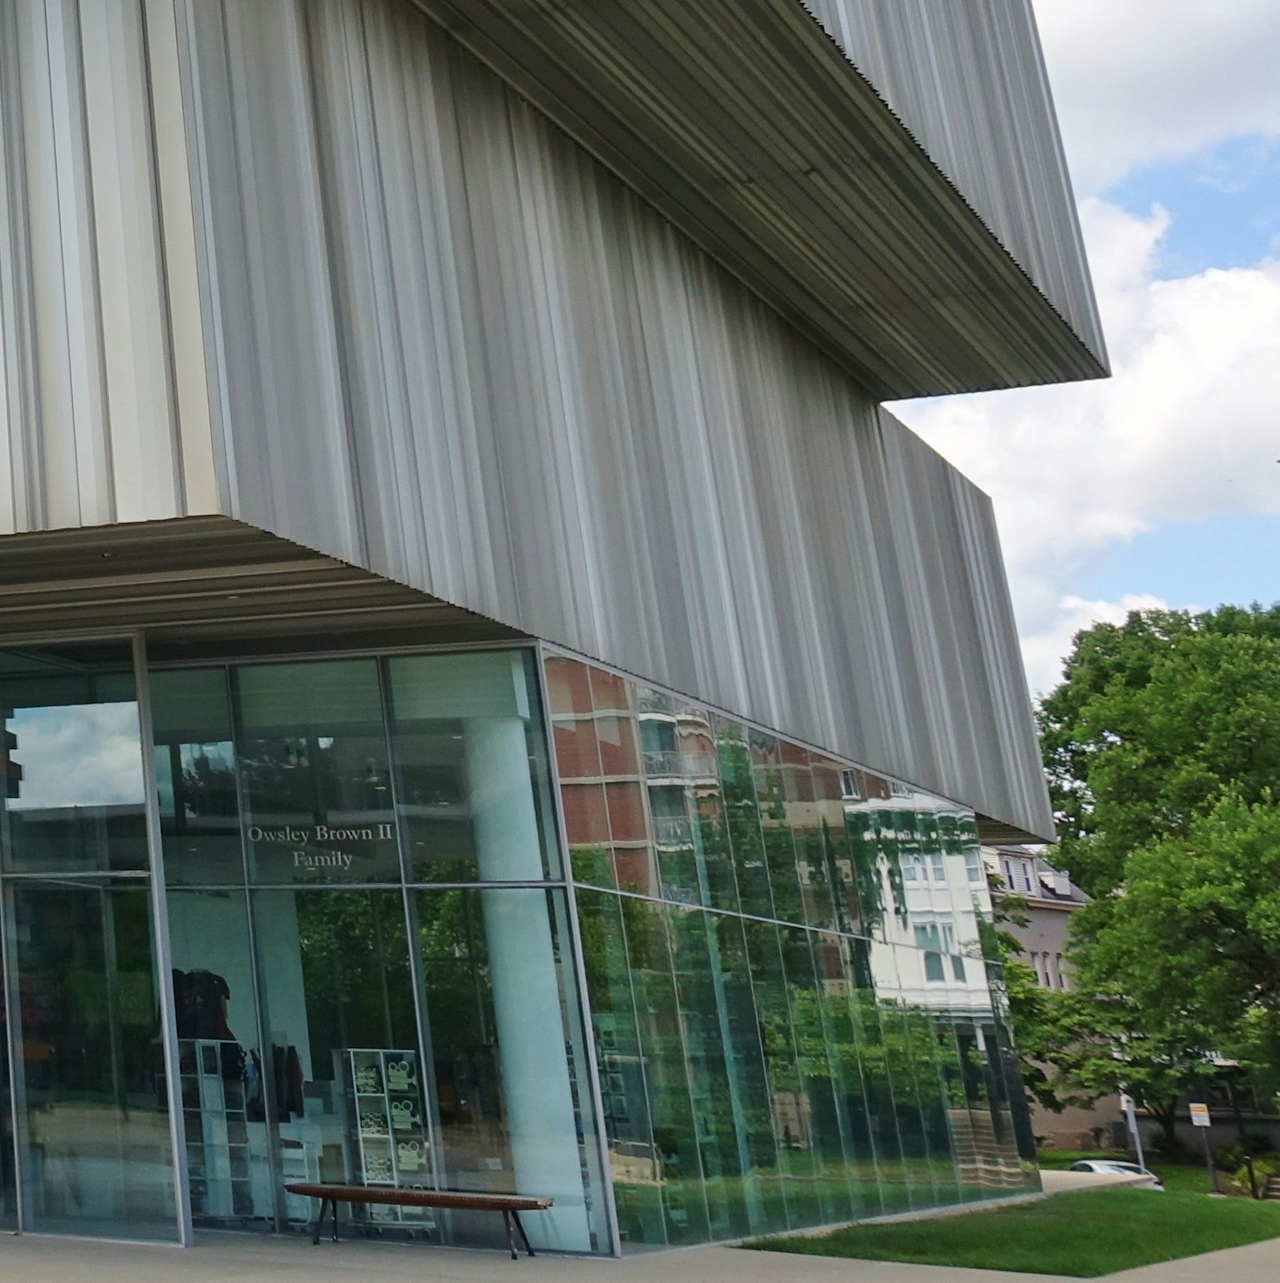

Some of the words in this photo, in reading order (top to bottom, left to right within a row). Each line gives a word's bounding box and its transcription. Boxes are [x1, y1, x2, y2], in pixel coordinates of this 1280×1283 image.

[247, 826, 309, 845] Owsley
[315, 825, 373, 841] Brown
[377, 824, 393, 840] II
[293, 851, 353, 870] Family
